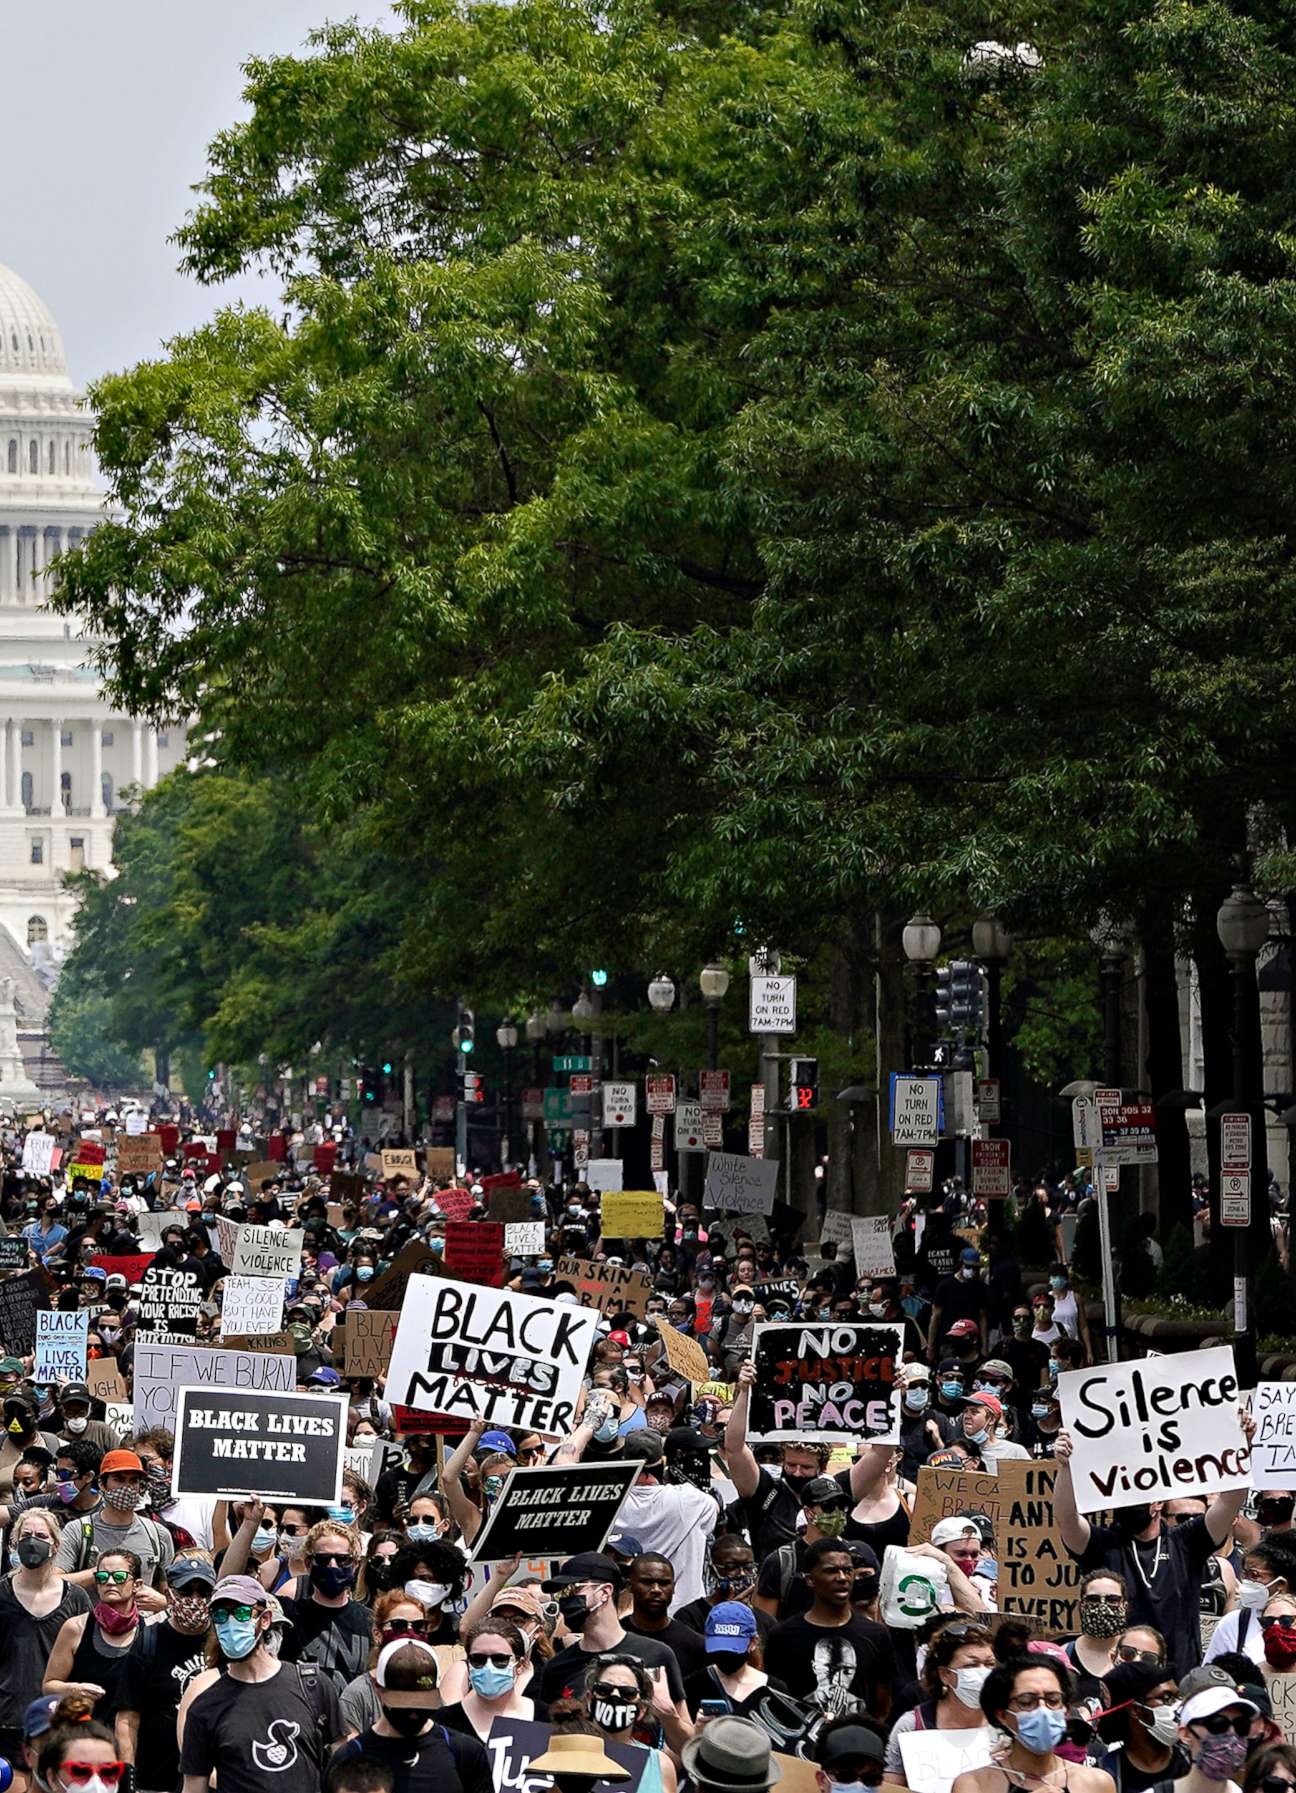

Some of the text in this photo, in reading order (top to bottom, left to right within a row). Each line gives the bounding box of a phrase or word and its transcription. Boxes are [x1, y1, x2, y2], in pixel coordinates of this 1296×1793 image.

[767, 982, 780, 990] NO
[763, 994, 785, 1002] TURN
[756, 1006, 790, 1014] ON RED
[752, 1018, 794, 1027] 7AM-7PM
[612, 1088, 626, 1096] NO
[909, 1084, 924, 1095] NO
[685, 1107, 701, 1116] NO
[905, 1099, 928, 1110] TURN
[898, 1114, 933, 1125] ON RED
[678, 1127, 689, 1135] ON
[896, 1129, 936, 1140] 7AM-7PM
[980, 1143, 1001, 1151] SNOW
[713, 1156, 747, 1173] White
[719, 1170, 762, 1187] Silence
[708, 1186, 766, 1212] Violence
[244, 1227, 291, 1249] SILENCE
[506, 1223, 539, 1235] BLACK
[506, 1235, 537, 1244] LIVES
[506, 1245, 545, 1254] MATTER
[241, 1254, 294, 1273] VIOLENCE
[145, 1267, 198, 1287] STOP
[558, 1260, 652, 1289] OUR SKIN IS
[141, 1284, 203, 1303] PRETENDING
[261, 1280, 283, 1291] SEX
[613, 1286, 621, 1294] A
[225, 1292, 279, 1305] IS GOOD
[140, 1302, 201, 1319] YOUR RACISM
[223, 1305, 278, 1319] BUT HAVE
[40, 1313, 84, 1332] BLACK
[153, 1319, 169, 1333] IS
[223, 1320, 275, 1333] YOU EVER
[355, 1311, 394, 1338] BLA
[431, 1287, 588, 1365] BLACK
[351, 1338, 385, 1358] LIV
[797, 1327, 858, 1359] NO
[45, 1350, 80, 1366] LIVES
[348, 1357, 390, 1375] MAT
[440, 1343, 556, 1391] LIVES
[37, 1365, 84, 1381] MATTER
[138, 1352, 293, 1391] IF WE BURN
[773, 1356, 895, 1385] JUSTICE
[404, 1370, 574, 1436] MATTER
[802, 1381, 854, 1406] NO
[1259, 1386, 1296, 1410] SAY
[1073, 1370, 1238, 1439] Silence
[188, 1409, 335, 1438] BLACK LIVES
[774, 1399, 890, 1430] PEACE
[1142, 1420, 1182, 1454] is
[211, 1438, 307, 1463] MATTER
[935, 1474, 969, 1492] WE
[506, 1483, 624, 1507] BLACK LIVES
[514, 1510, 592, 1530] MATTER
[1008, 1500, 1054, 1529] ANY
[1007, 1537, 1058, 1560] IS A
[1005, 1561, 1035, 1588] TO
[1004, 1596, 1079, 1631] EVERY
[594, 1699, 637, 1728] VOTE
